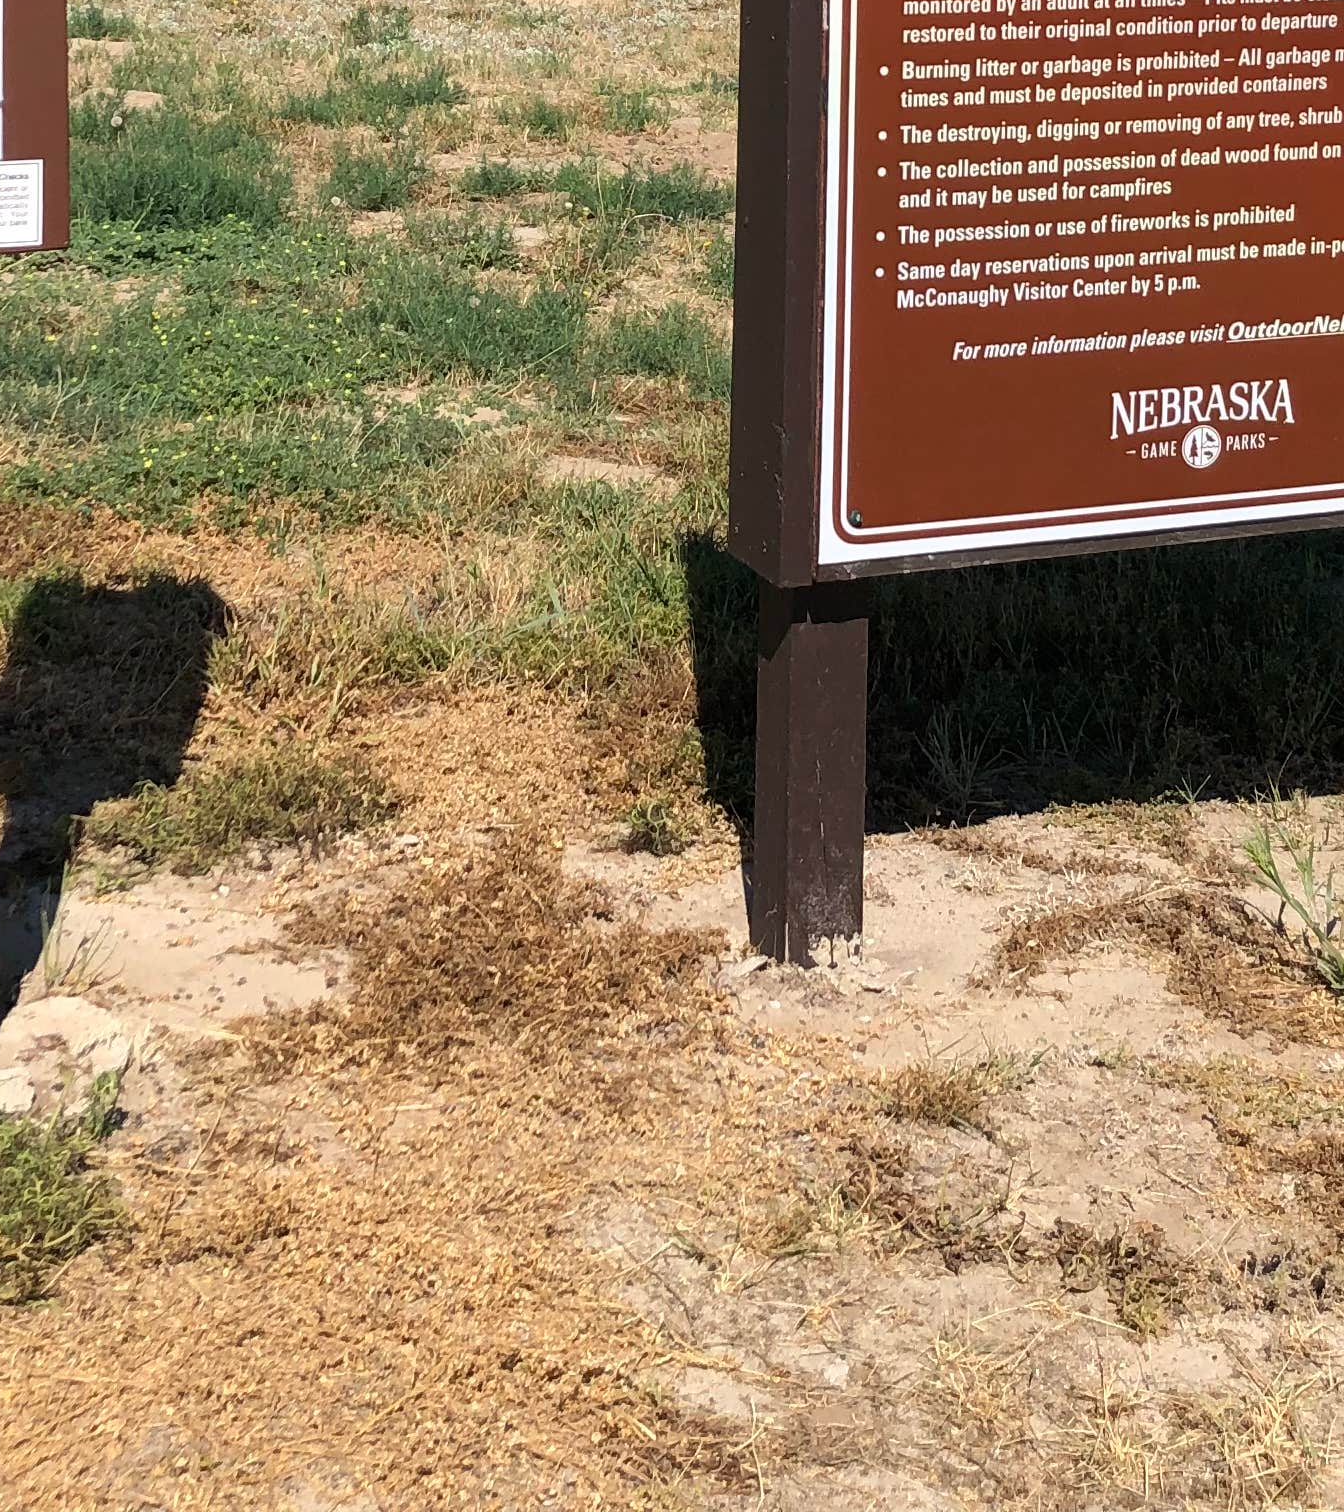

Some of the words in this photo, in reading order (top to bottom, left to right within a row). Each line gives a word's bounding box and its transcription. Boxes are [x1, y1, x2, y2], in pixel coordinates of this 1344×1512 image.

[897, 224, 930, 244] The
[934, 220, 1030, 247] possession
[1034, 222, 1053, 237] or
[1056, 220, 1086, 235] use
[1090, 214, 1107, 233] of
[1110, 210, 1190, 232] fireworks
[1194, 208, 1209, 227] is
[1212, 203, 1295, 231] prohibited
[896, 283, 1009, 308] McConaughy
[1012, 280, 1069, 301] Visitor
[1072, 278, 1127, 297] Center
[1130, 274, 1150, 297] by
[1154, 273, 1163, 292] 5
[1167, 275, 1200, 295] p.m.
[952, 341, 981, 360] For
[983, 341, 1027, 358] more
[1031, 331, 1127, 355] information
[1129, 328, 1186, 352] please
[1189, 322, 1225, 343] visit
[1111, 379, 1295, 439] NEBRASKA
[1141, 440, 1177, 459] GAME
[1226, 432, 1266, 452] PARKS
